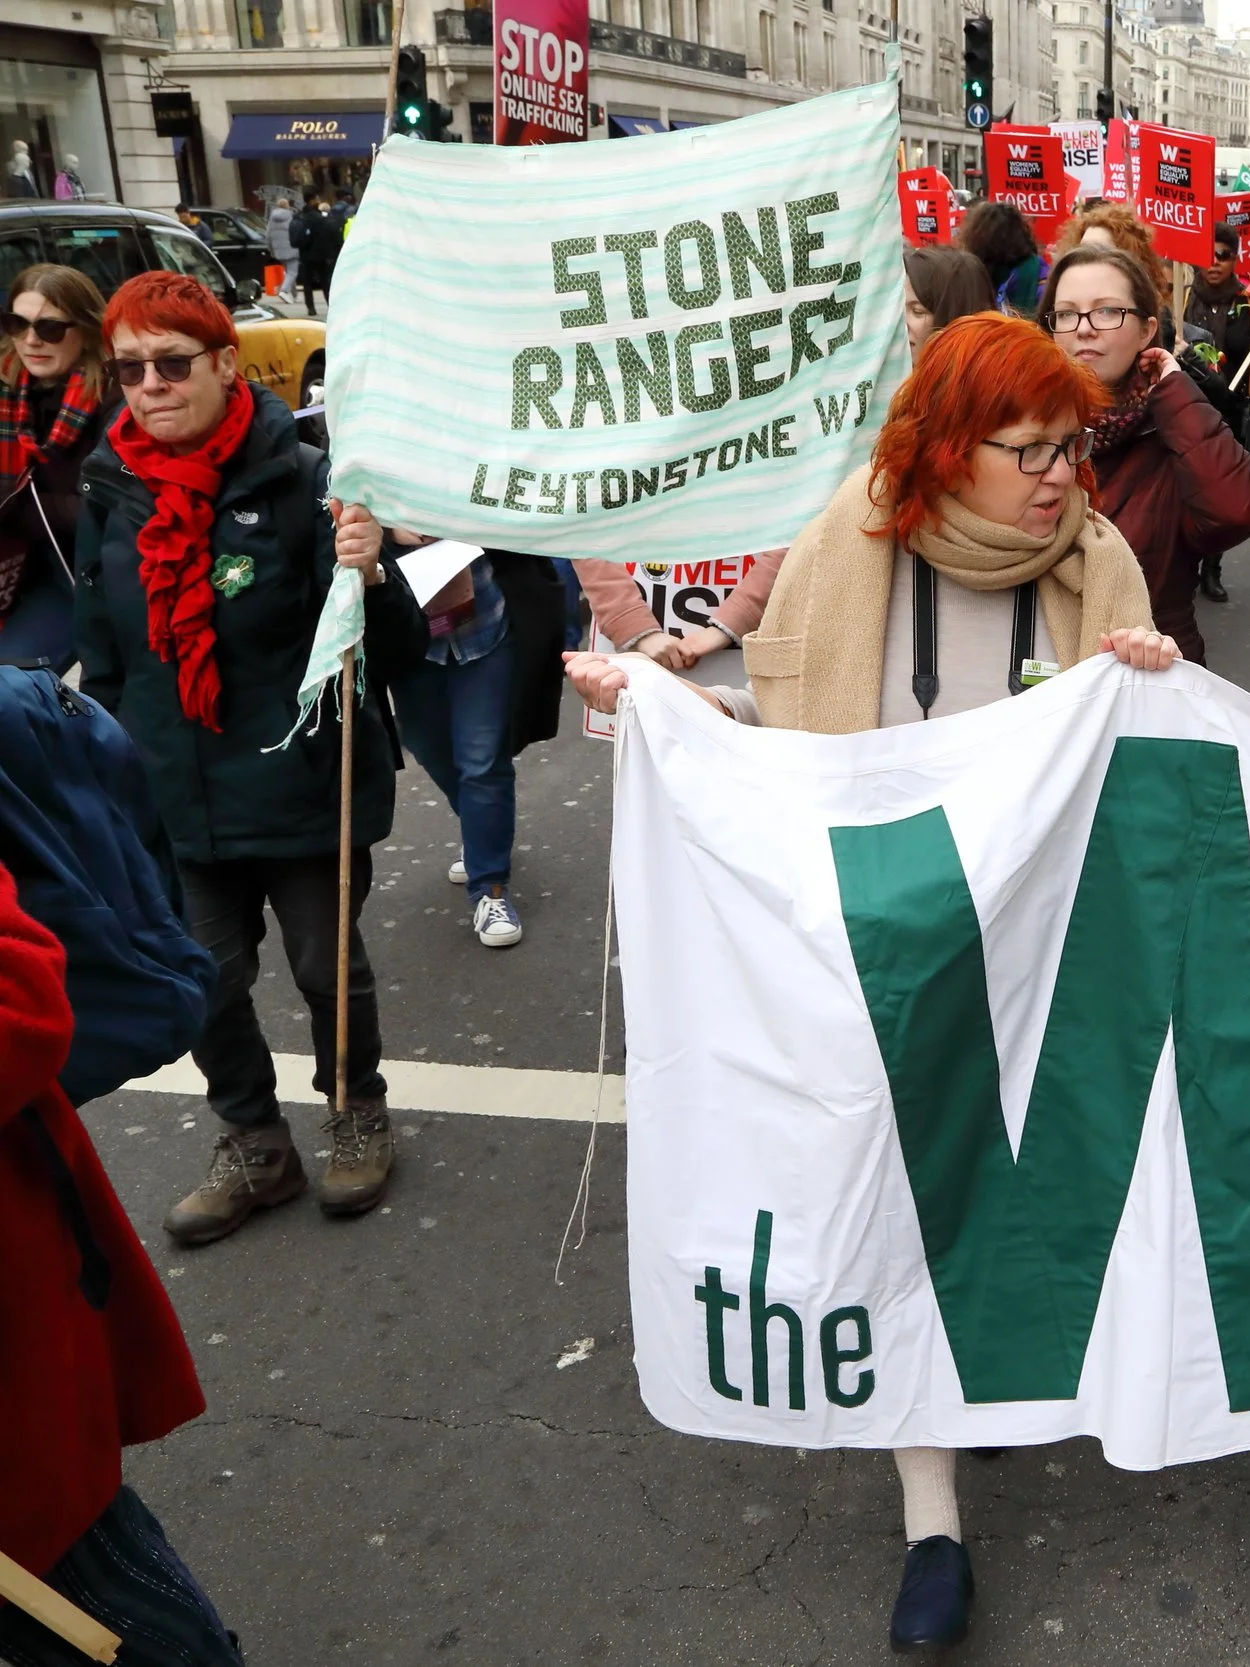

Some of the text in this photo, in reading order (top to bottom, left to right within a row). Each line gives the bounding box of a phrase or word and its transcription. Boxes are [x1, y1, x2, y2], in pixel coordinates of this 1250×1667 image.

[501, 19, 584, 87] STOP
[501, 71, 584, 115] ONLINE SEX
[291, 121, 338, 132] POLO
[501, 96, 584, 136] TRAFFICKING
[1005, 181, 1048, 191] NEVER
[1155, 185, 1196, 203] NEVER
[1145, 198, 1206, 227] FORGET
[551, 191, 840, 329] STONE
[470, 415, 797, 514] LEYTONSTONE
[694, 1210, 875, 1412] the
